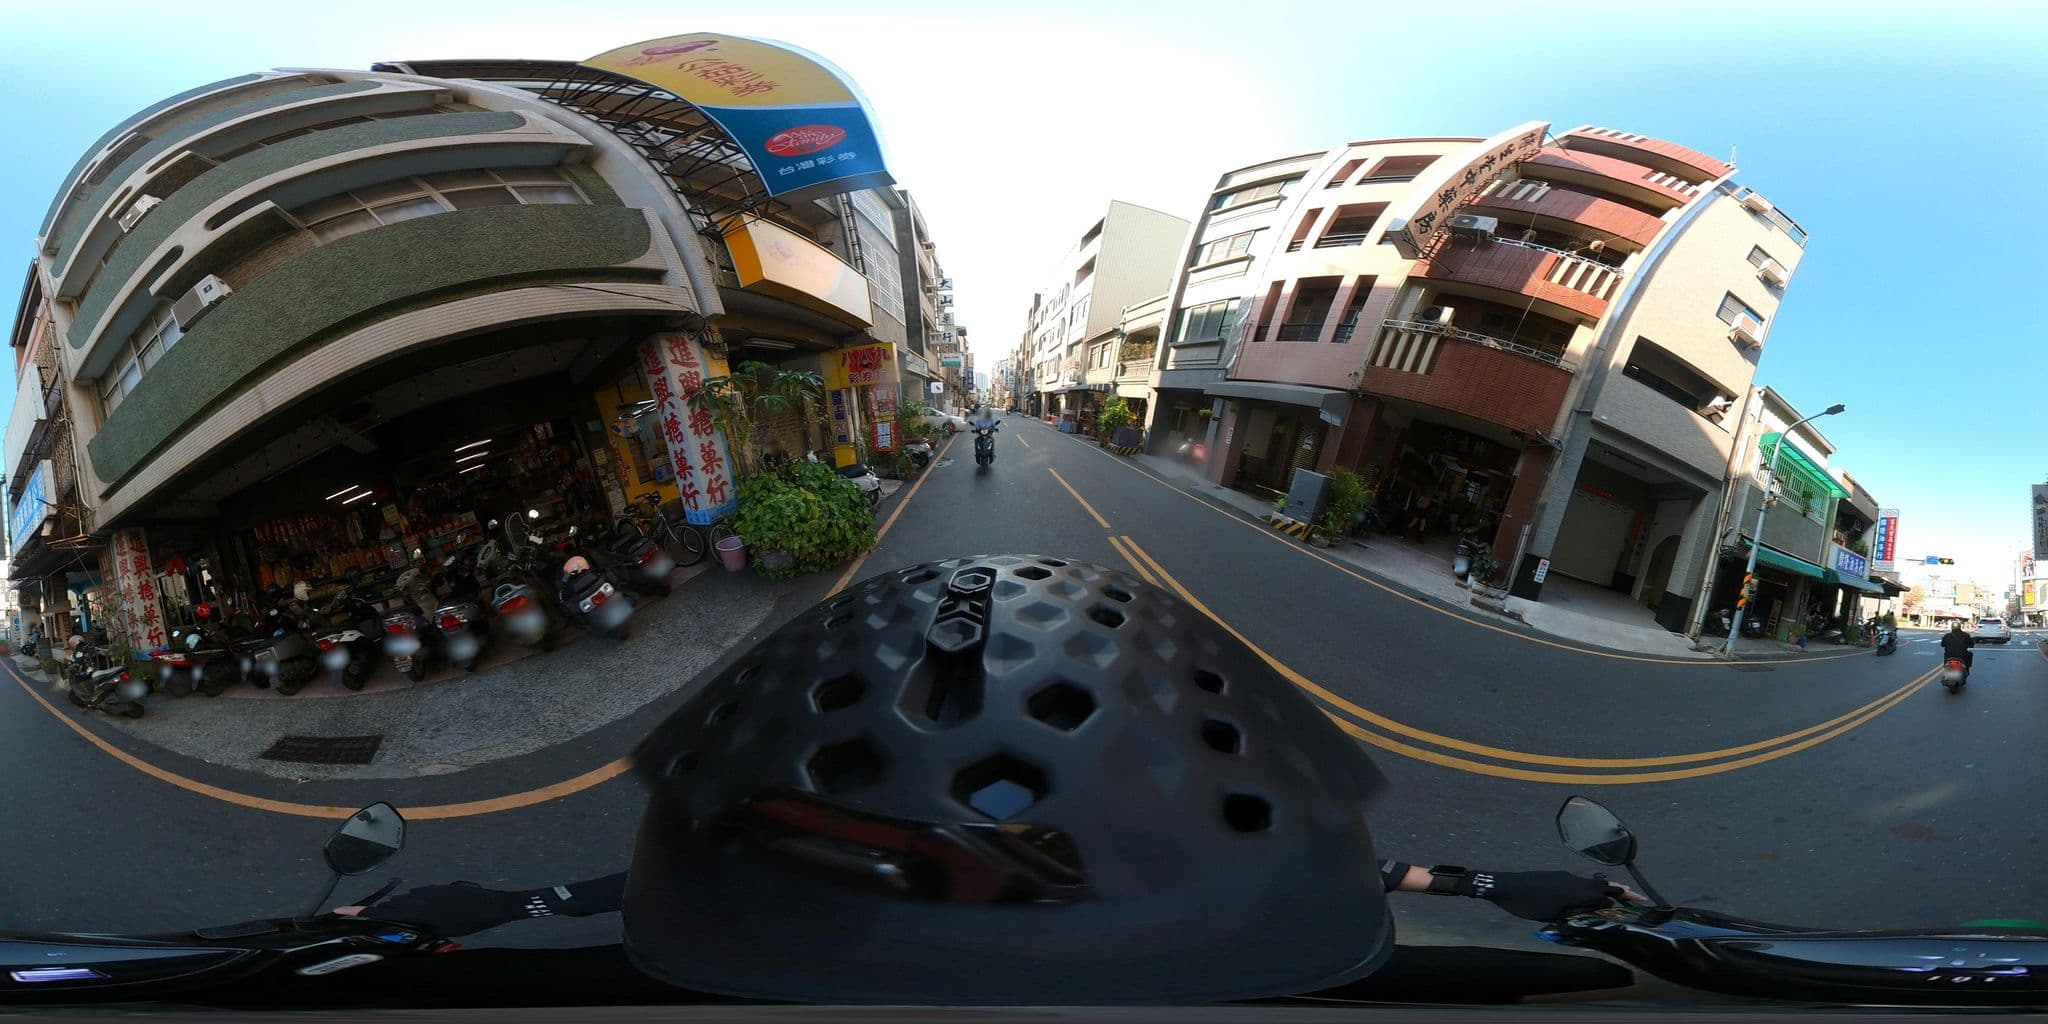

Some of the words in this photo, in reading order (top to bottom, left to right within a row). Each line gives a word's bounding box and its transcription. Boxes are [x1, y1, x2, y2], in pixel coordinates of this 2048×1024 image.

[678, 58, 781, 97] 公益彩券
[778, 152, 857, 175] 台灣彩券
